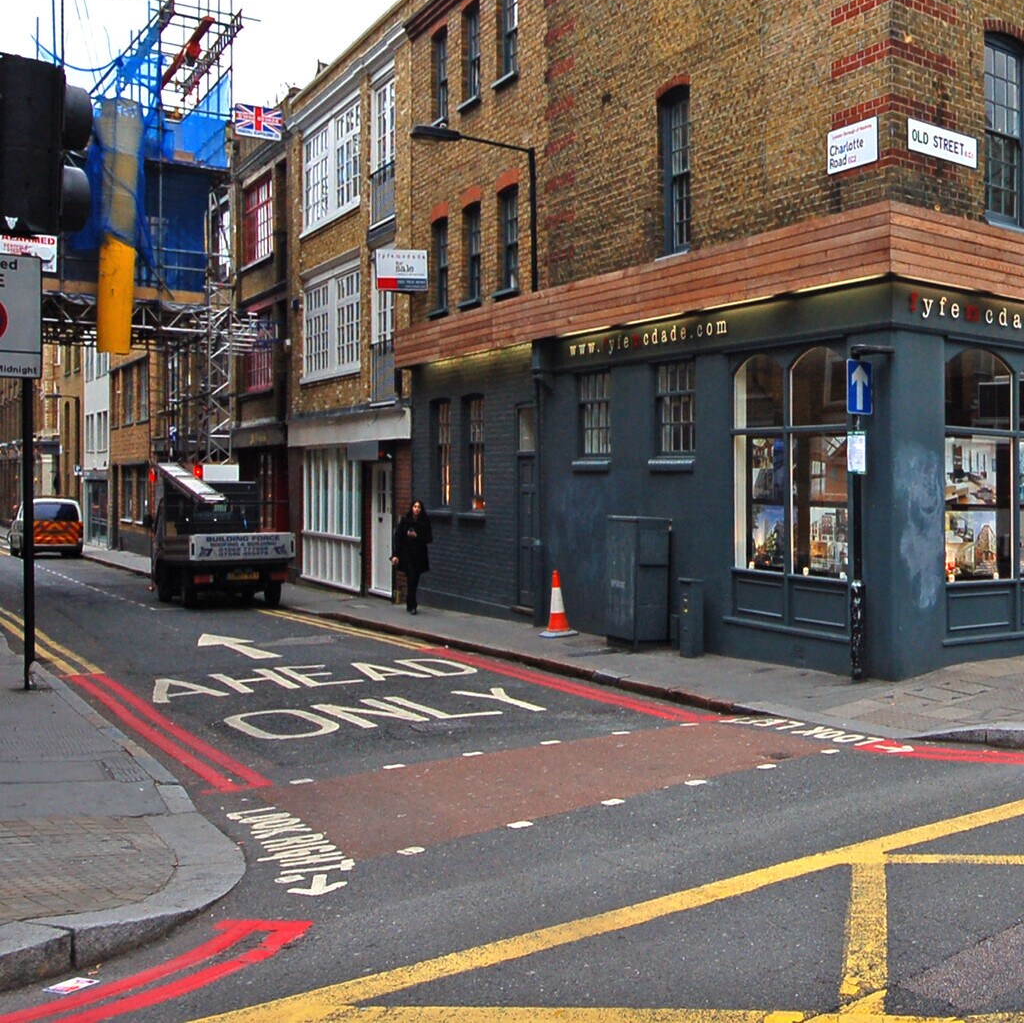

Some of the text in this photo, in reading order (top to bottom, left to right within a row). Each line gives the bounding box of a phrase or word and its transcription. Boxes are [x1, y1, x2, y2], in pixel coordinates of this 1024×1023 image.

[829, 137, 864, 157] Charlotte
[911, 128, 929, 145] OLD
[933, 135, 965, 156] STREET
[829, 154, 847, 170] Road
[152, 657, 478, 703] AHEAD
[223, 687, 547, 740] ONLY
[719, 717, 885, 747] LOOK LEFT
[226, 806, 355, 876] LOOK RIGHT
